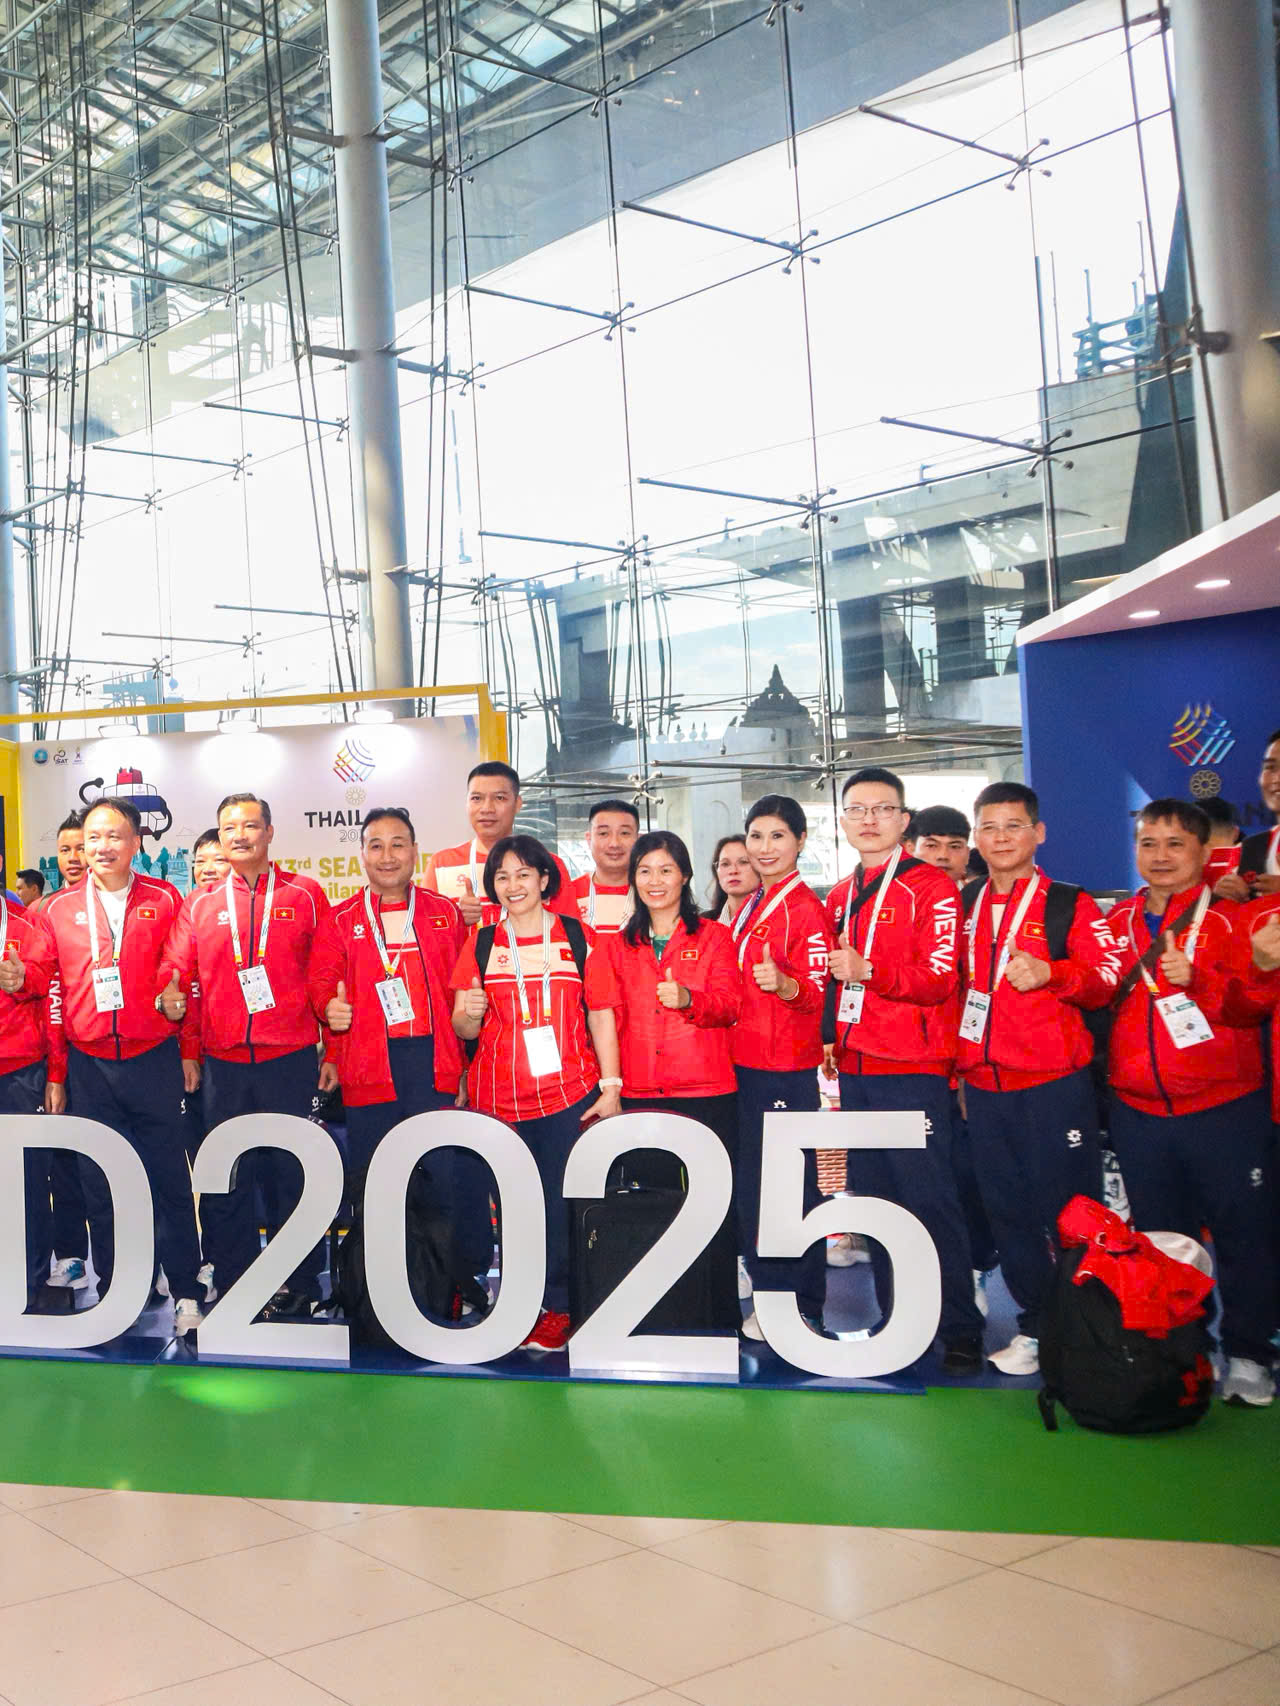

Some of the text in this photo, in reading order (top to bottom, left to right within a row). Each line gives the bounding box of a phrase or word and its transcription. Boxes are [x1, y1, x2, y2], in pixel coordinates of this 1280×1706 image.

[304, 810, 366, 828] THAIL
[319, 856, 363, 878] SEA
[930, 897, 957, 975] VIETNA
[49, 971, 63, 1025] NAM
